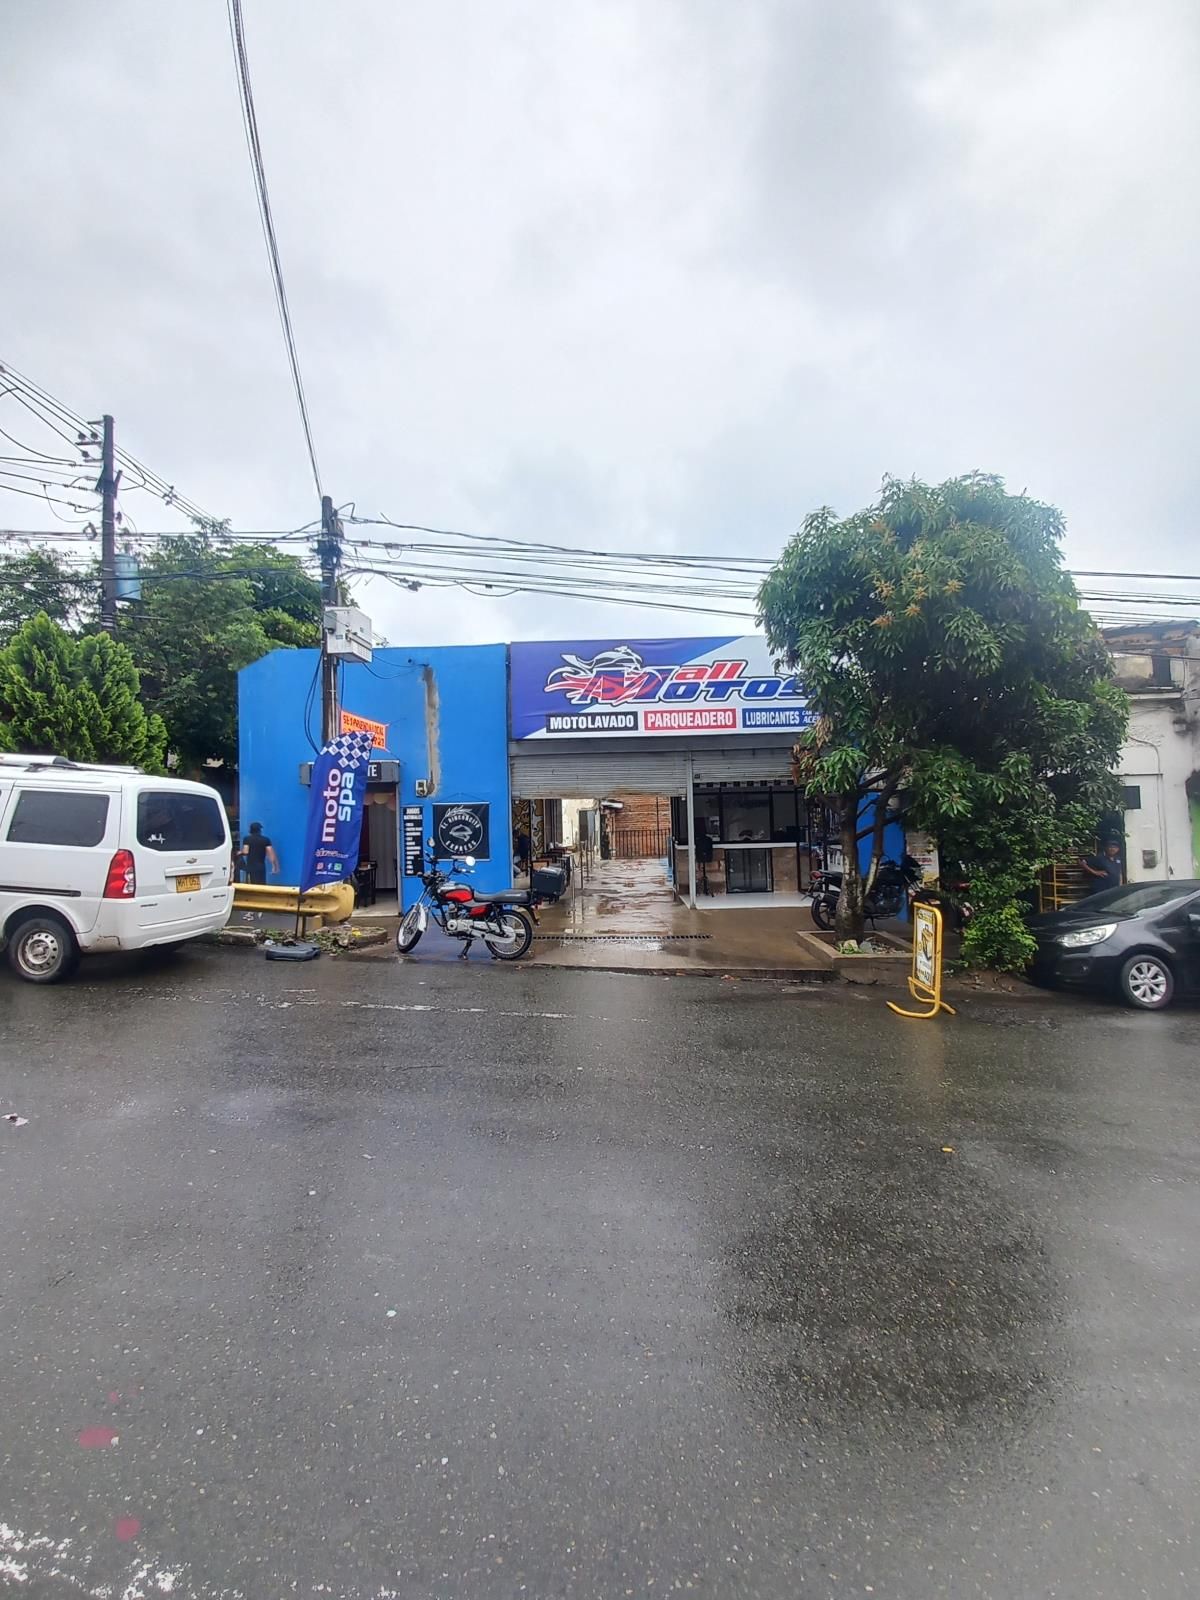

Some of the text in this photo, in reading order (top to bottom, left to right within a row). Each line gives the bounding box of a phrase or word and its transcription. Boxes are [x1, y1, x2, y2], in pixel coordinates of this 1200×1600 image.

[549, 714, 635, 730] MOTOLAVADO
[646, 710, 733, 729] PARQUEADERO
[744, 709, 800, 725] LUBRICANTES
[322, 768, 341, 842] moto
[337, 771, 356, 822] spa
